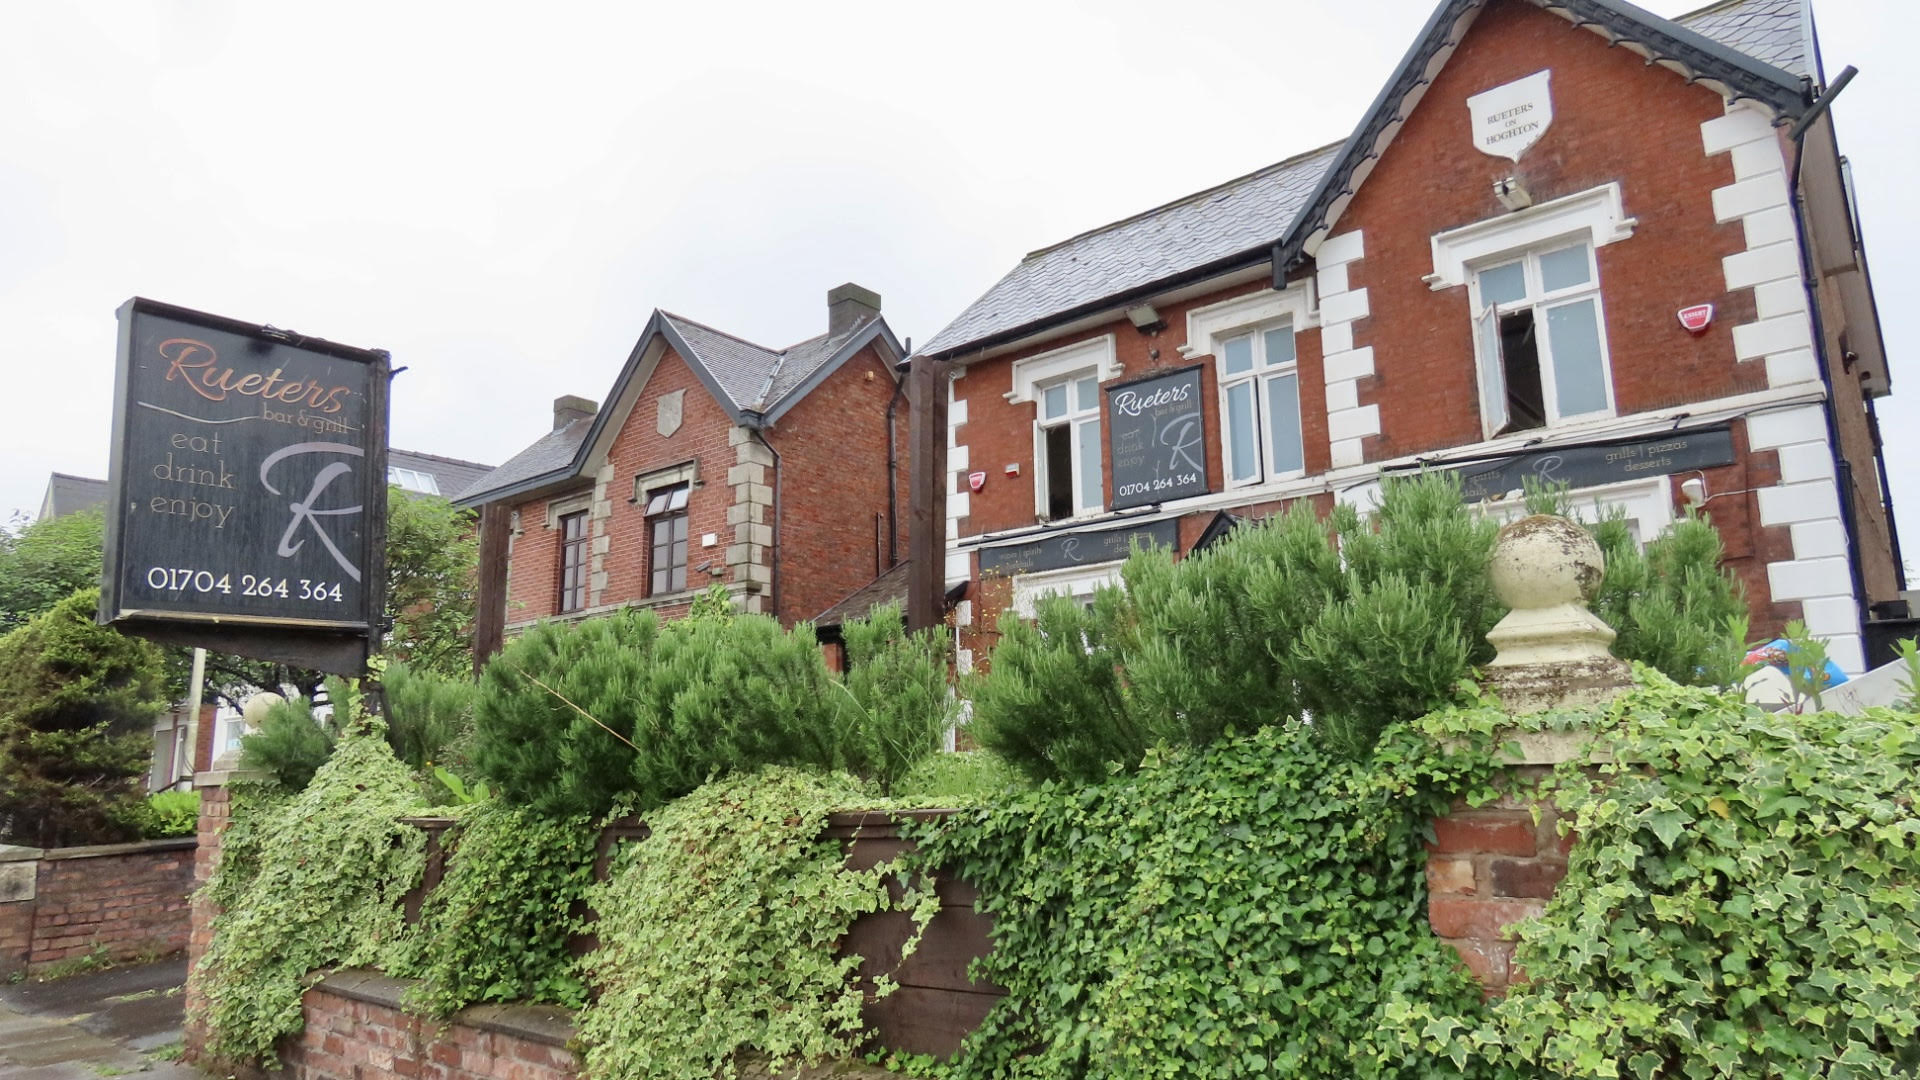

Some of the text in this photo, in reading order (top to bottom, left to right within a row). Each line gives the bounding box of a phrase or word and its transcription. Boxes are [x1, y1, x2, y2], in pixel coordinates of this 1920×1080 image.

[1487, 102, 1534, 125] RUETERS
[1504, 118, 1517, 128] ON
[1486, 121, 1539, 145] HOGHTON
[158, 337, 350, 413] Rueters
[1114, 383, 1192, 416] Rueters
[263, 402, 348, 434] bar & grill
[171, 431, 223, 455] eat
[1605, 446, 1637, 464] grills
[1647, 440, 1688, 457] pizzas
[153, 452, 235, 490] drink
[1624, 457, 1672, 472] desserts
[1119, 473, 1197, 496] 01704 264 364
[150, 494, 235, 529] enjoy
[147, 567, 343, 602] 01704 264 364
